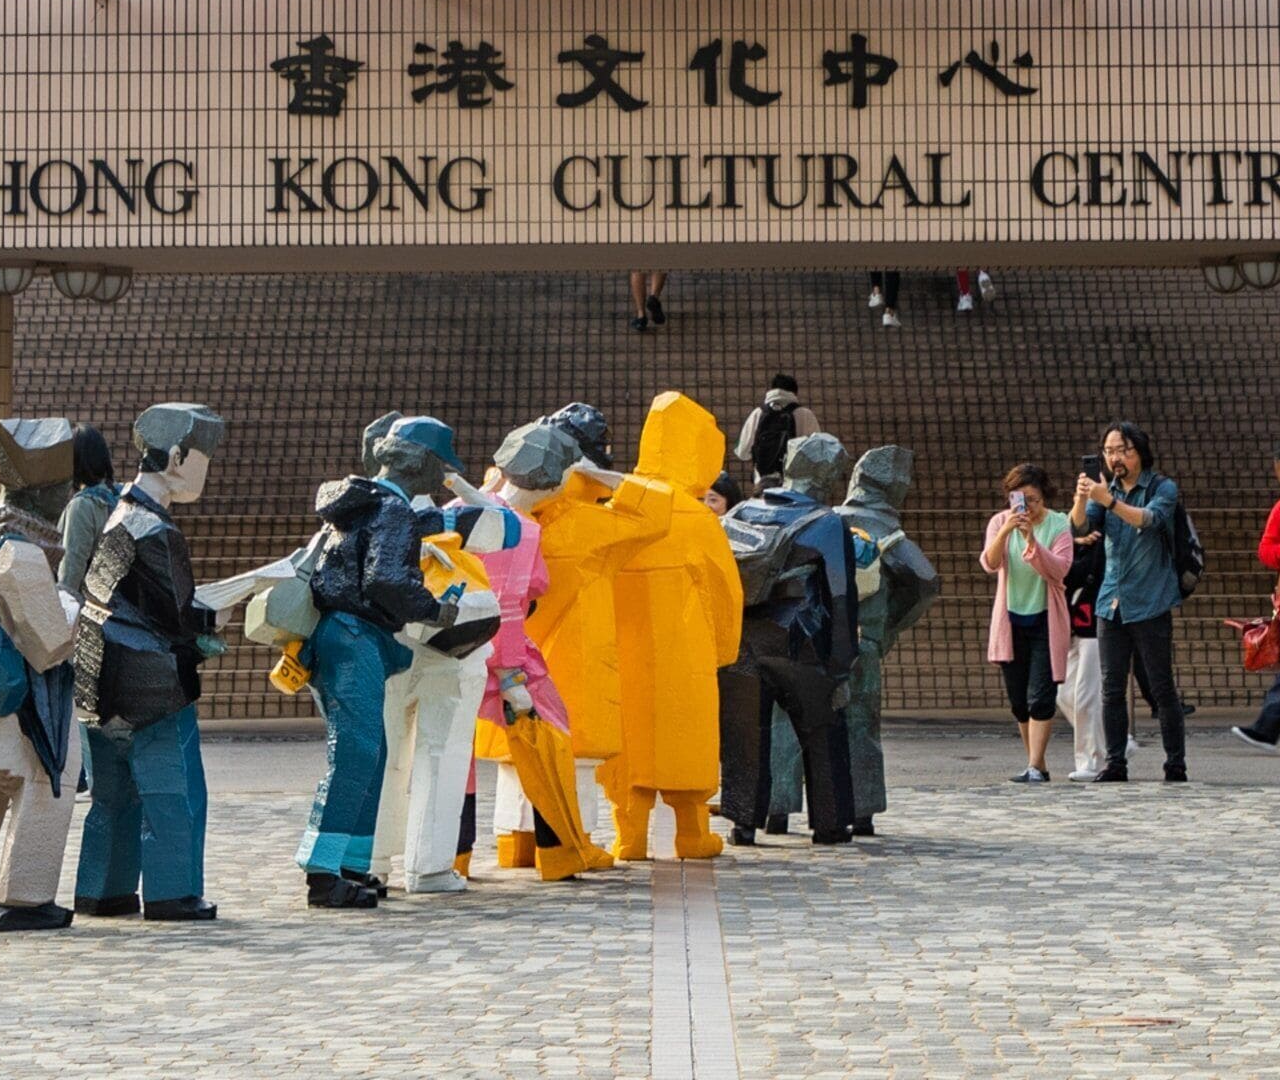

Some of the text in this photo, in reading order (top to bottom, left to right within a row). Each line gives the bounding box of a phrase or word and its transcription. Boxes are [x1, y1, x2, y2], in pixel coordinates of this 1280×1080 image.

[271, 34, 1038, 117] 香港文化中心
[266, 155, 493, 213] KONG
[552, 153, 972, 212] CULTURAL
